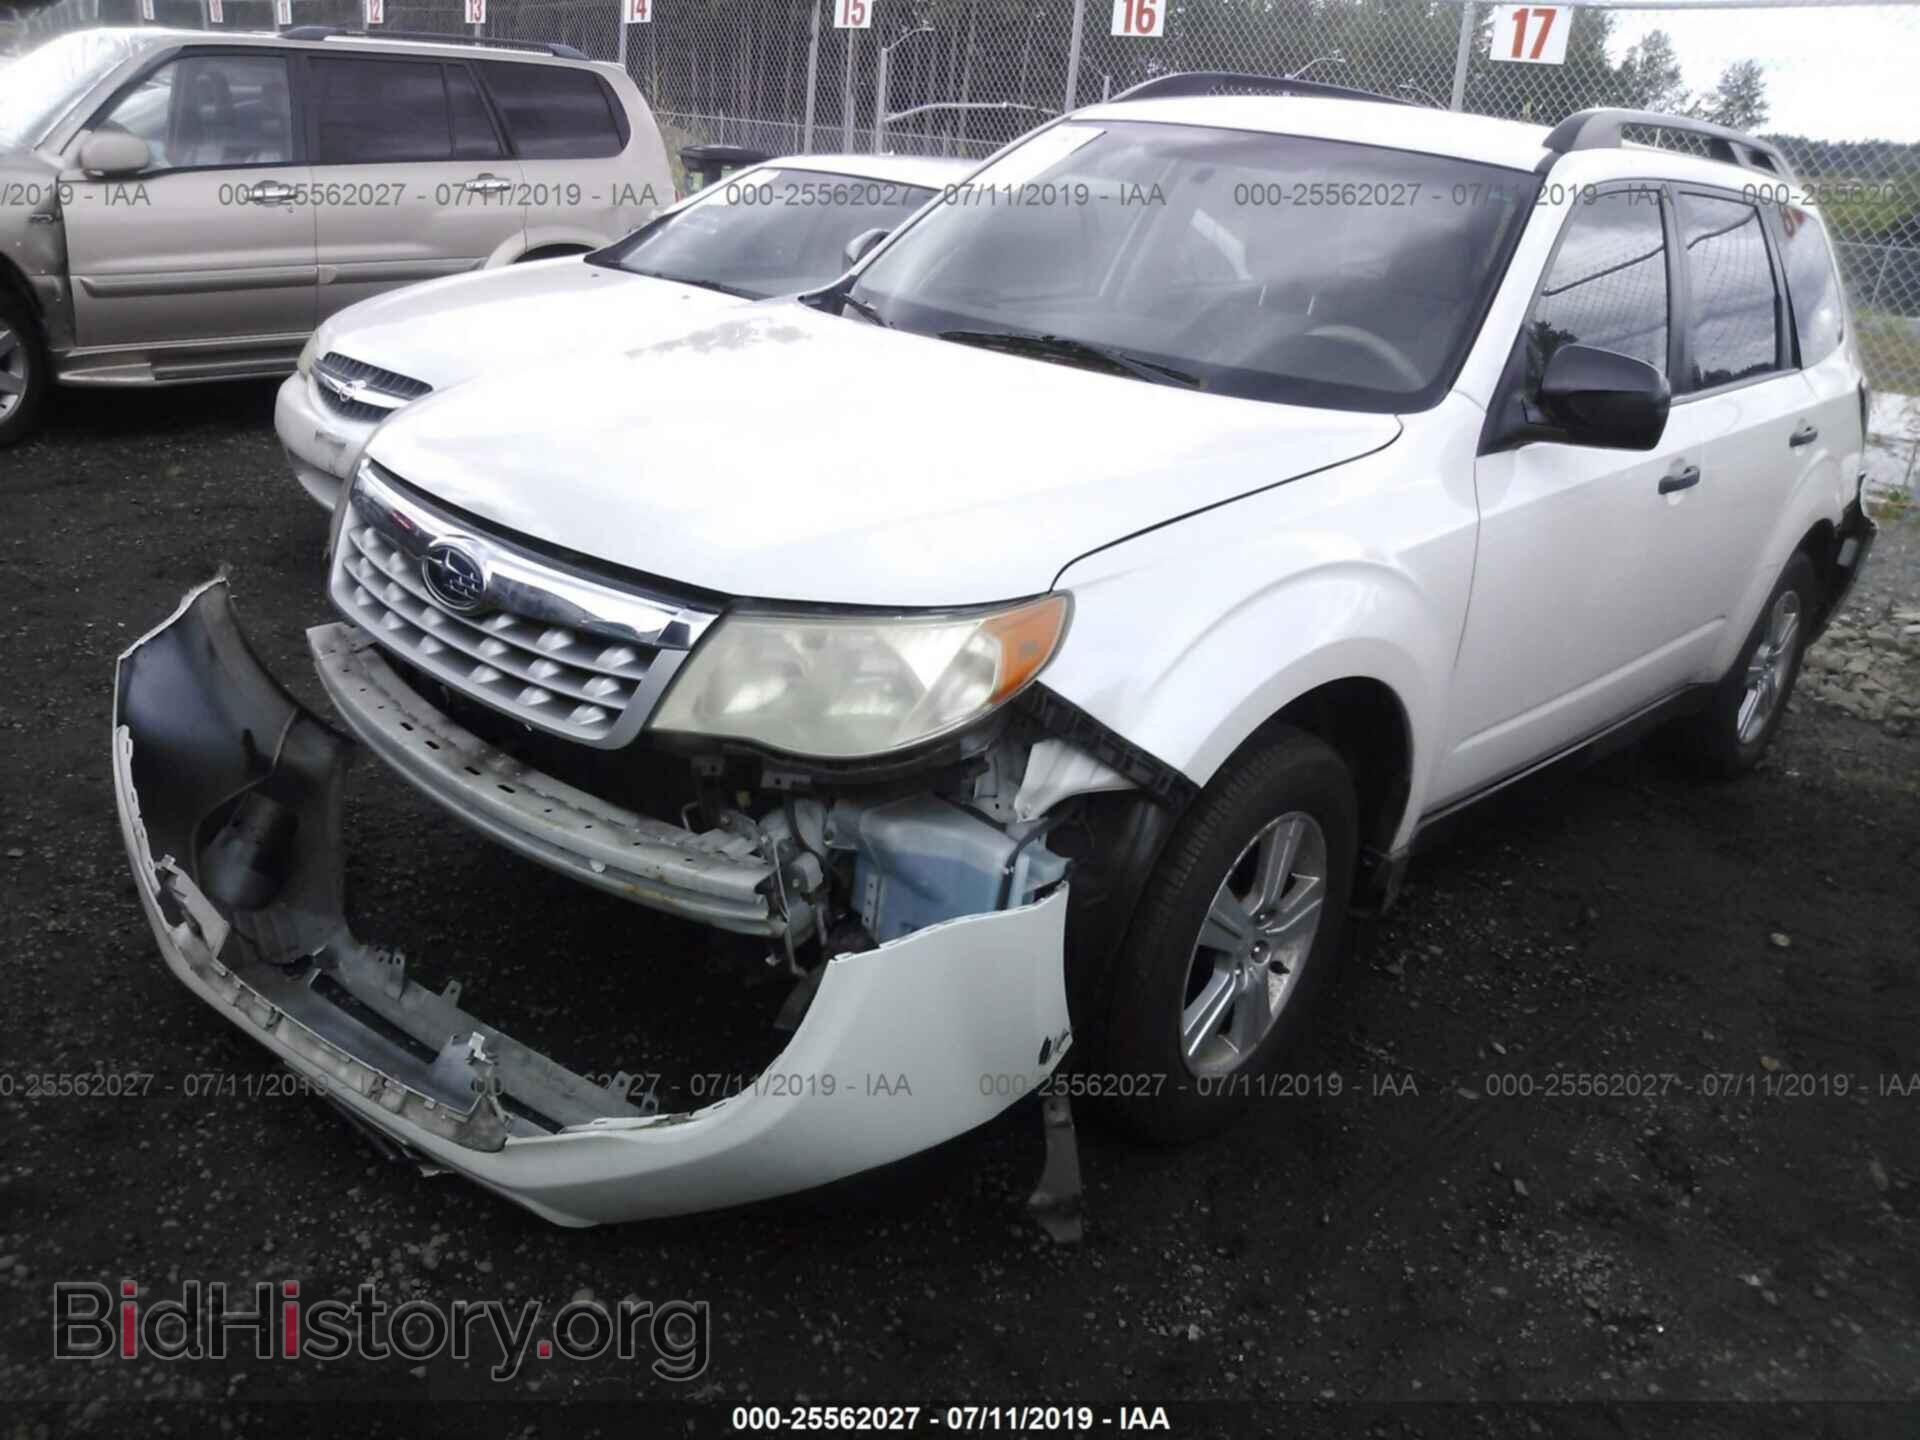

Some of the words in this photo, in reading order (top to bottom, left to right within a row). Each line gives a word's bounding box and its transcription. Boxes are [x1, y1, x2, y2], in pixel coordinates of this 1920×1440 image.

[469, 0, 481, 21] 13
[630, 0, 648, 21] 14
[843, 0, 865, 26] 15
[1123, 0, 1156, 34] 16
[1511, 8, 1557, 59] 17
